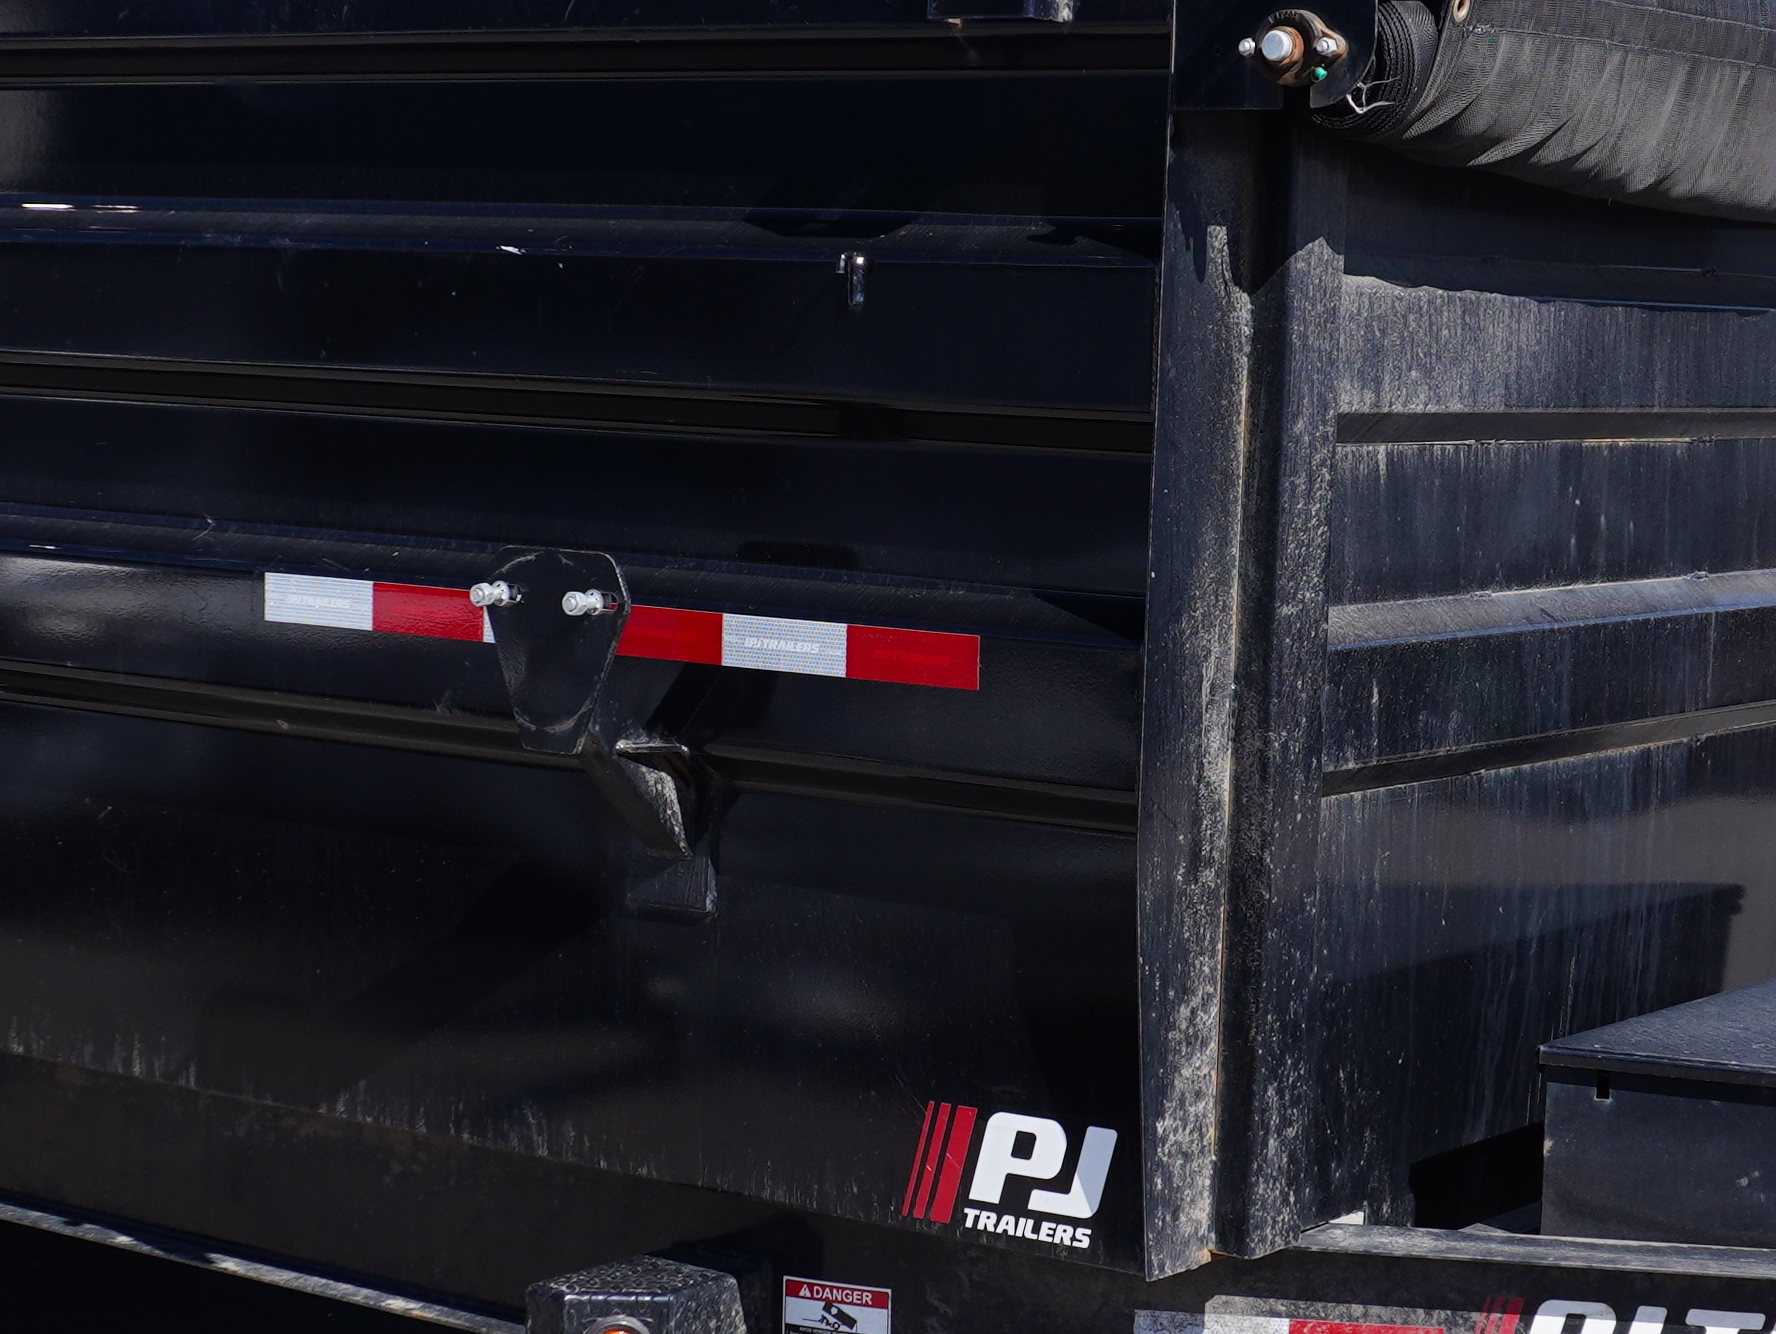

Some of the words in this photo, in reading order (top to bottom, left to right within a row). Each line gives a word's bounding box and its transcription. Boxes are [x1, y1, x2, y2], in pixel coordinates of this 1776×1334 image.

[968, 1111, 1118, 1219] PJ
[963, 1207, 1092, 1249] TRAILERS
[813, 1285, 873, 1305] DANGER
